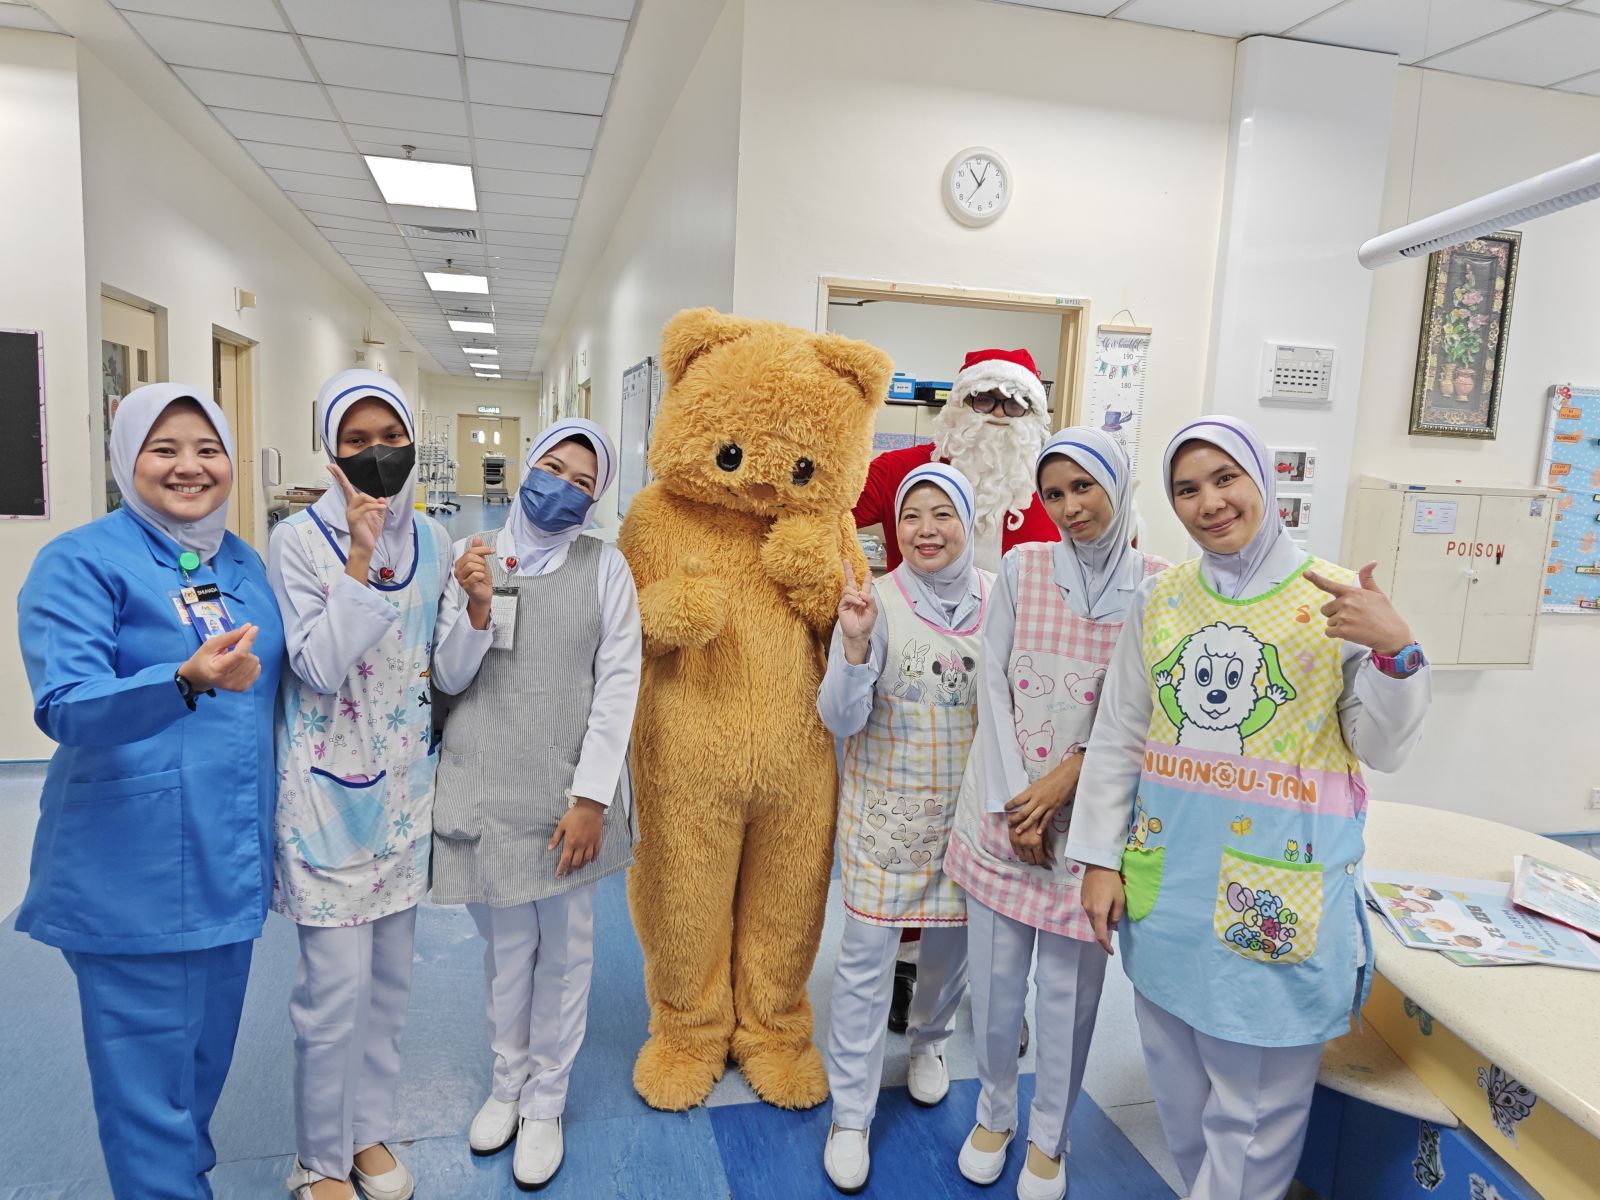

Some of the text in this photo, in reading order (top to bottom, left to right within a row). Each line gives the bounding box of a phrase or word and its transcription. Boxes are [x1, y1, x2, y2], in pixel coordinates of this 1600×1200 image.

[1446, 541, 1505, 559] POISON
[1465, 904, 1506, 939] BED 32
[1501, 910, 1525, 929] WARD
